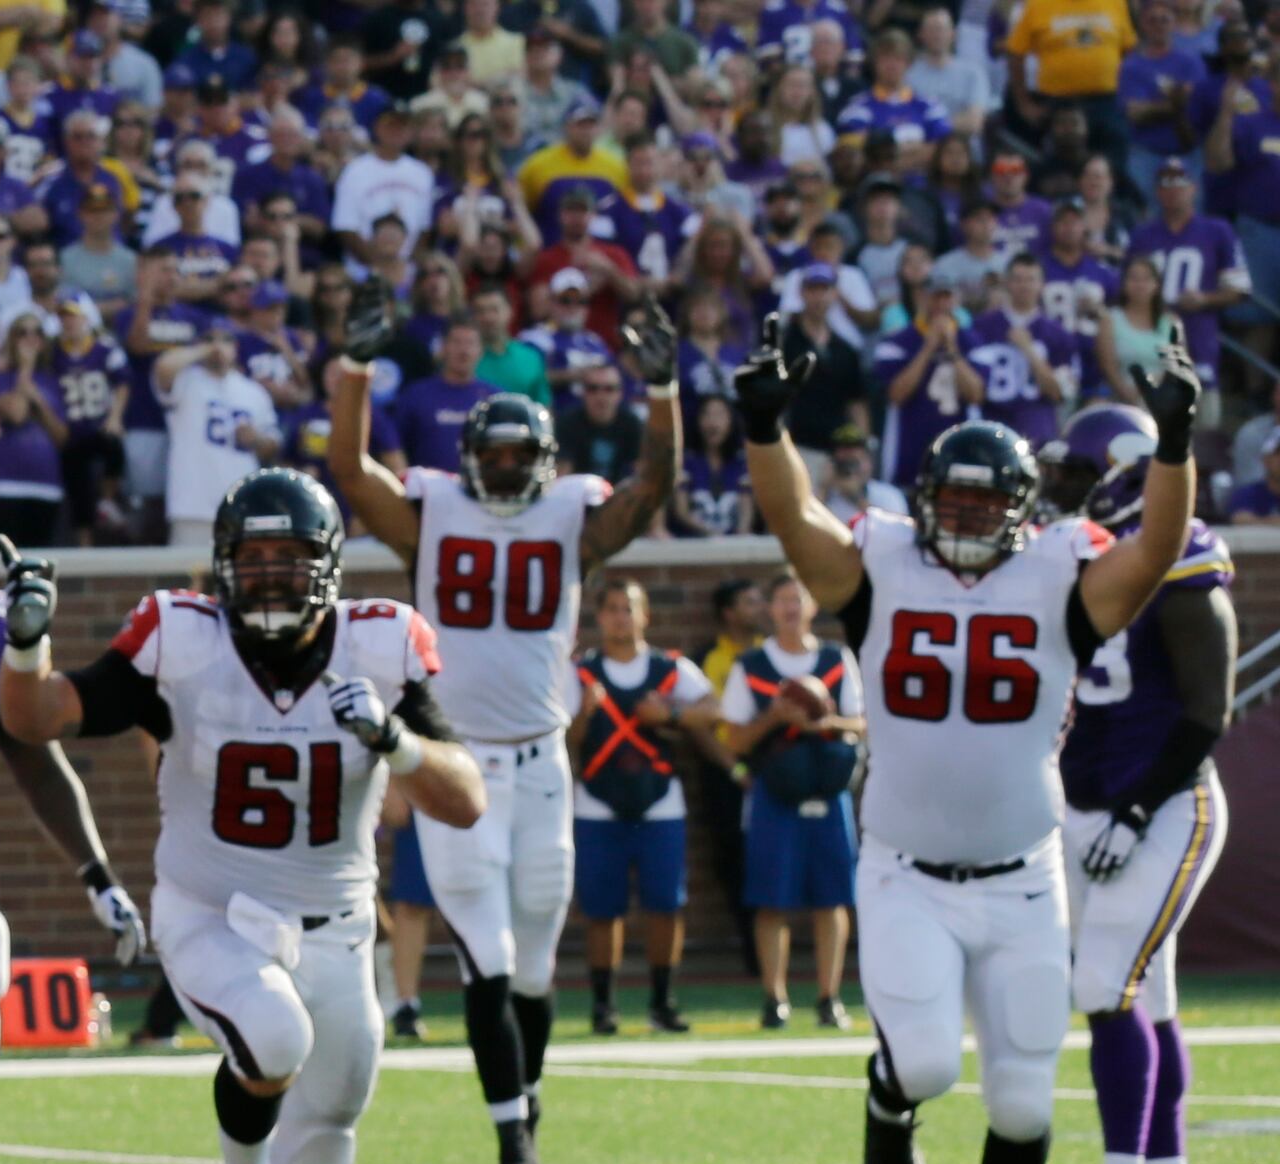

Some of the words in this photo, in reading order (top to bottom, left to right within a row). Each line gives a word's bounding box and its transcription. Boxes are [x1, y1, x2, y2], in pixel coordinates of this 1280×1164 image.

[437, 536, 562, 630] 80
[883, 609, 1040, 724] 66
[212, 741, 344, 850] 61
[11, 972, 81, 1031] 10
